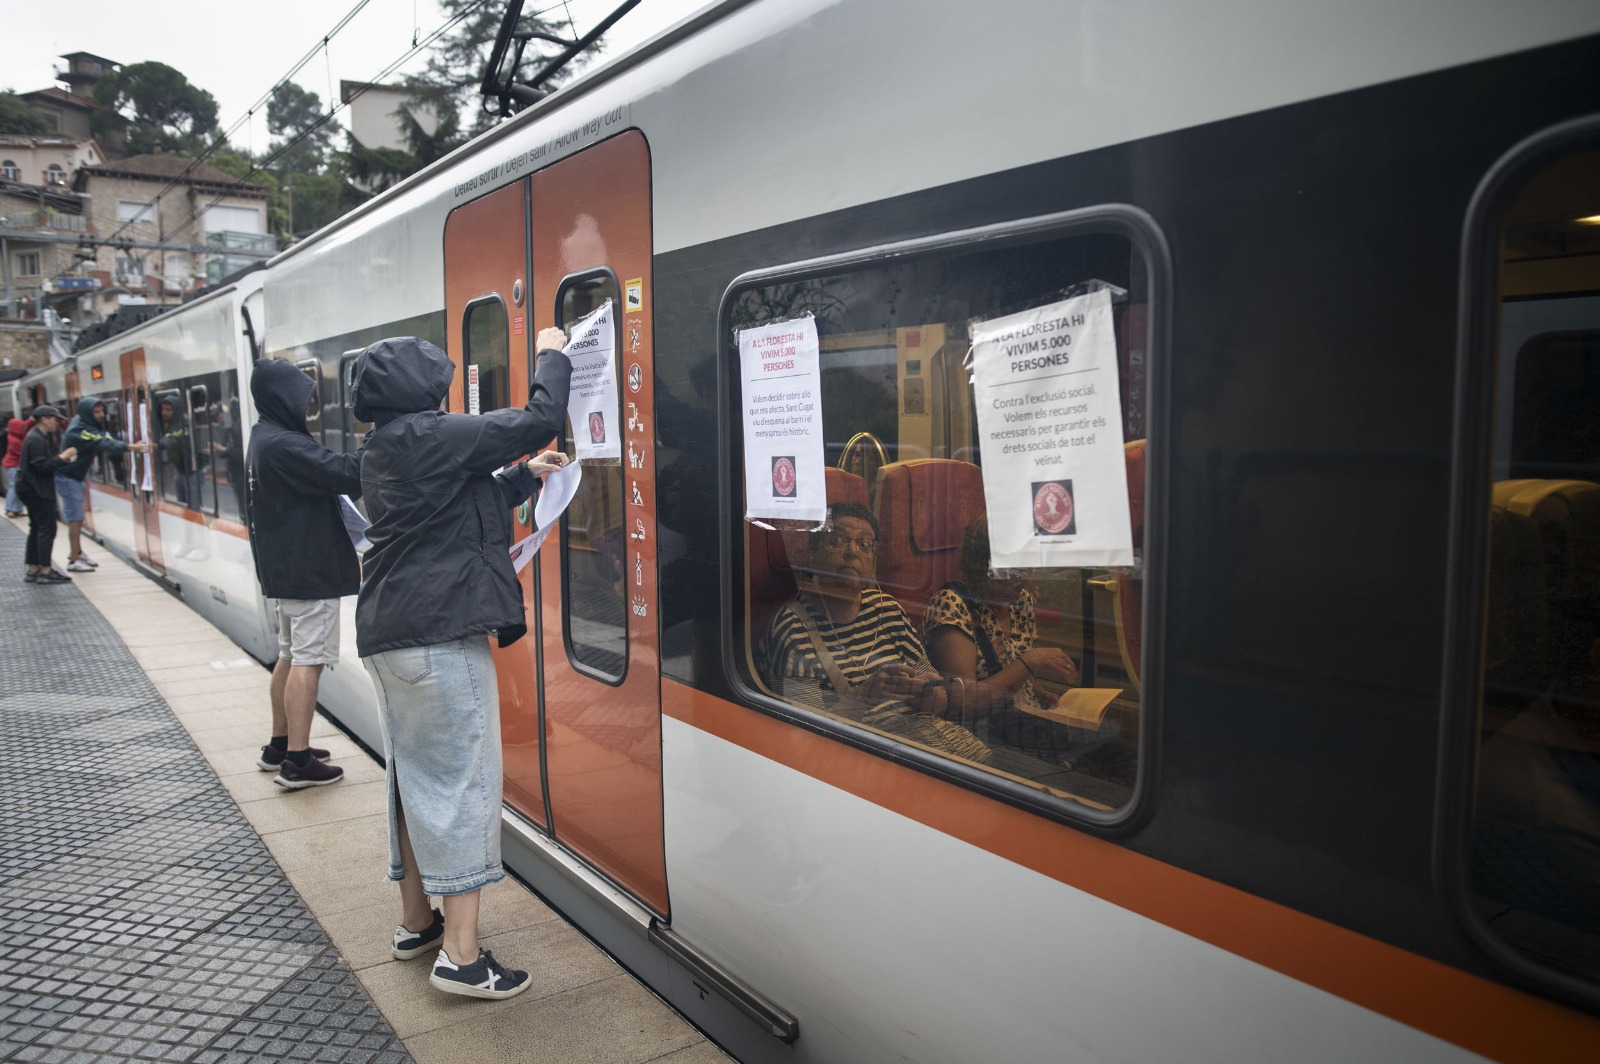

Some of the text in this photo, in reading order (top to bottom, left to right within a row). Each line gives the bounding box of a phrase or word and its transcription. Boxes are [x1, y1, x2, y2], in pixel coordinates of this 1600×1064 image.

[454, 178, 478, 197] Deixeu
[479, 165, 499, 184] sortir
[506, 152, 528, 174] Dejen
[530, 142, 547, 162] salir
[554, 129, 580, 150] Allow
[582, 114, 602, 136] way
[604, 106, 623, 126] out
[598, 317, 607, 325] HI
[1016, 317, 1070, 338] FLORESTA
[1071, 313, 1085, 328] HI
[570, 339, 599, 350] PERSONES
[752, 339, 757, 348] A
[766, 333, 796, 347] FLORESTA
[796, 331, 804, 341] HI
[1006, 334, 1072, 357] VIVIM 5.000
[760, 346, 796, 360] VIVIM 5.000
[763, 360, 795, 372] PERSONES
[1011, 352, 1070, 373] PERSONES
[752, 390, 811, 403] Volem decidir sobre allò
[993, 384, 1097, 409] Contra l'exclusió social.
[750, 408, 759, 416] que
[786, 404, 798, 413] Sant
[798, 403, 814, 413] Cugat
[1003, 403, 1088, 423] Volem els recursos
[785, 416, 790, 424] al
[791, 415, 804, 424] barri
[807, 415, 813, 423] el
[755, 430, 783, 439] menyspreu
[782, 428, 789, 437] és
[990, 416, 1106, 440] necessaris per garantir els
[1002, 433, 1096, 454] drets socials de tot el
[1034, 455, 1065, 466] veïnat.
